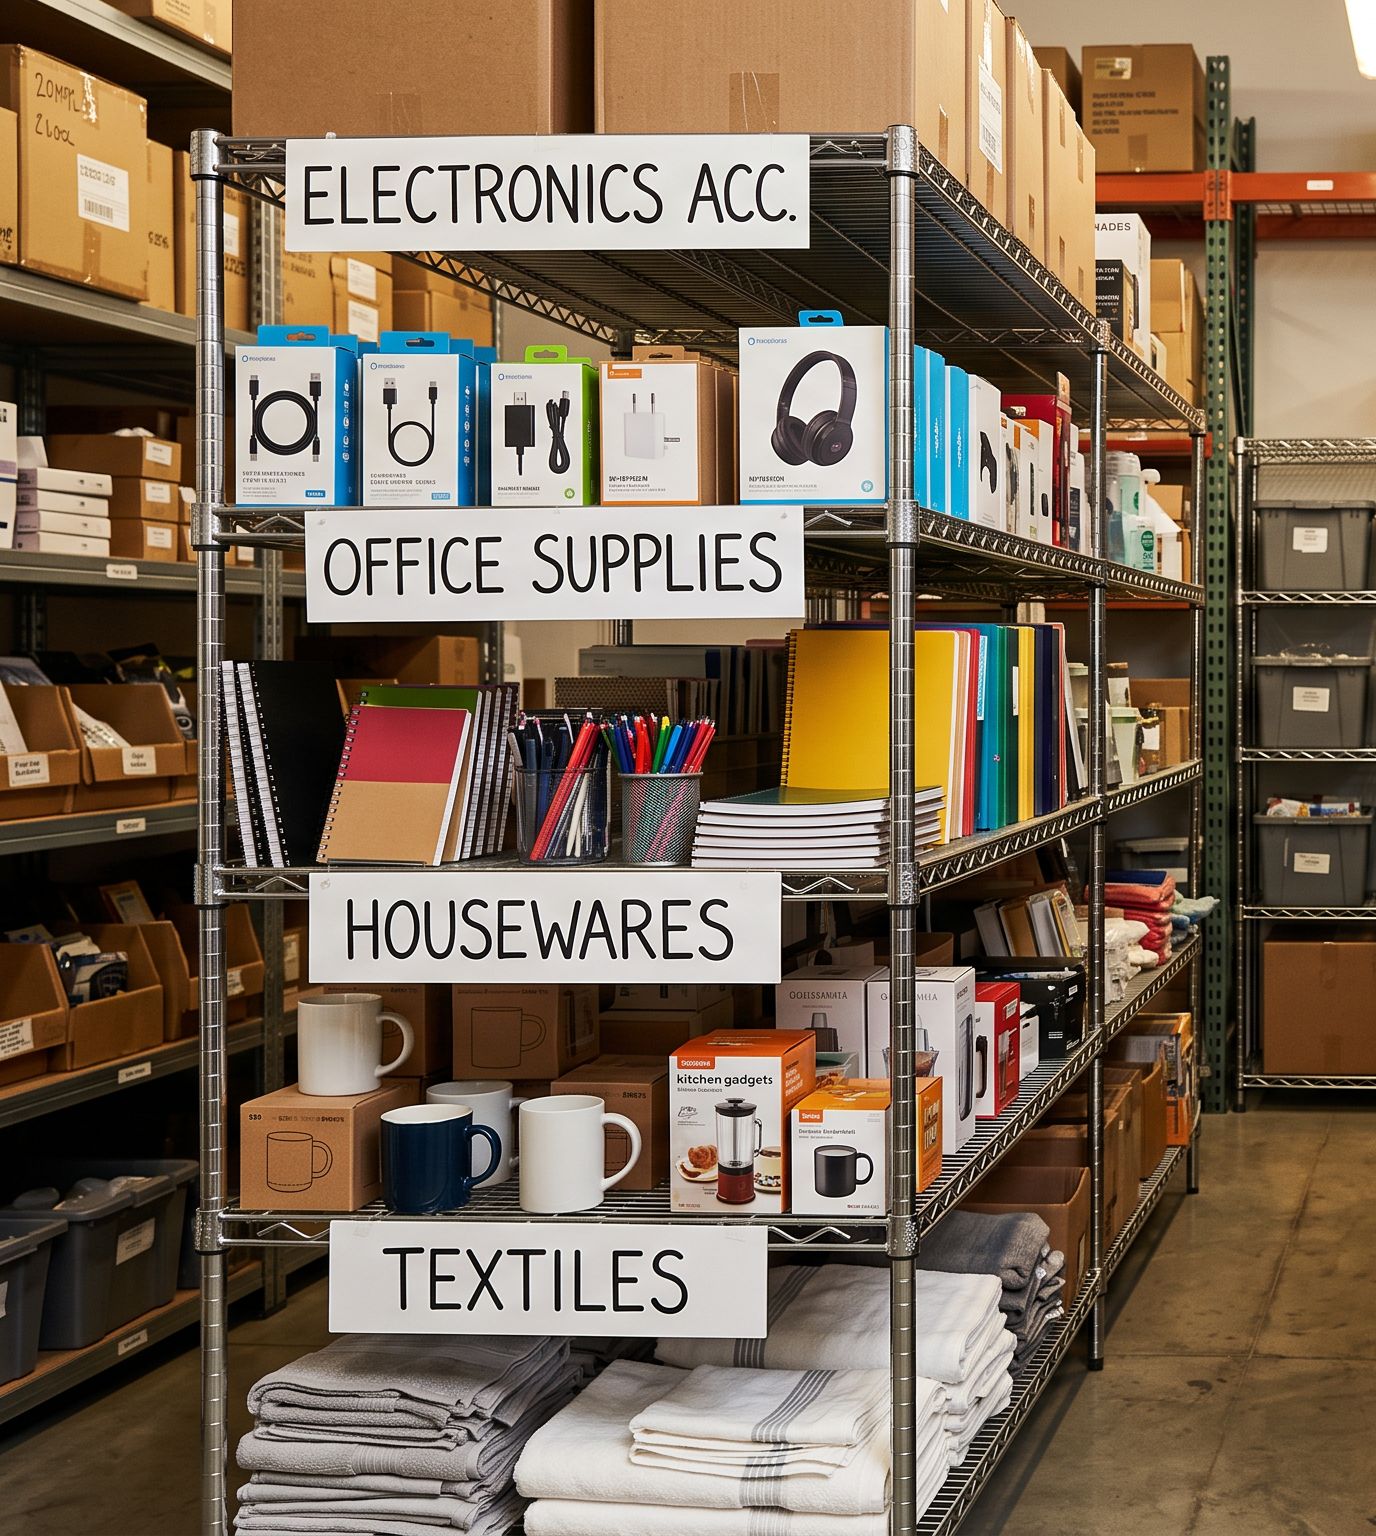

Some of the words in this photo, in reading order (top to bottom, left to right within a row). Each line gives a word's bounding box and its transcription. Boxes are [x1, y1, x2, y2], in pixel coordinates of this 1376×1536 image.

[304, 163, 663, 226] ELECTRONICS
[687, 162, 797, 224] ACC.
[324, 536, 505, 596] OFFICE
[531, 531, 782, 594] SUPPLIES
[346, 898, 734, 962] HOUSEWARES
[677, 1074, 722, 1085] kitchen
[724, 1074, 773, 1087] gadgets
[382, 1246, 689, 1315] TEXTILES
